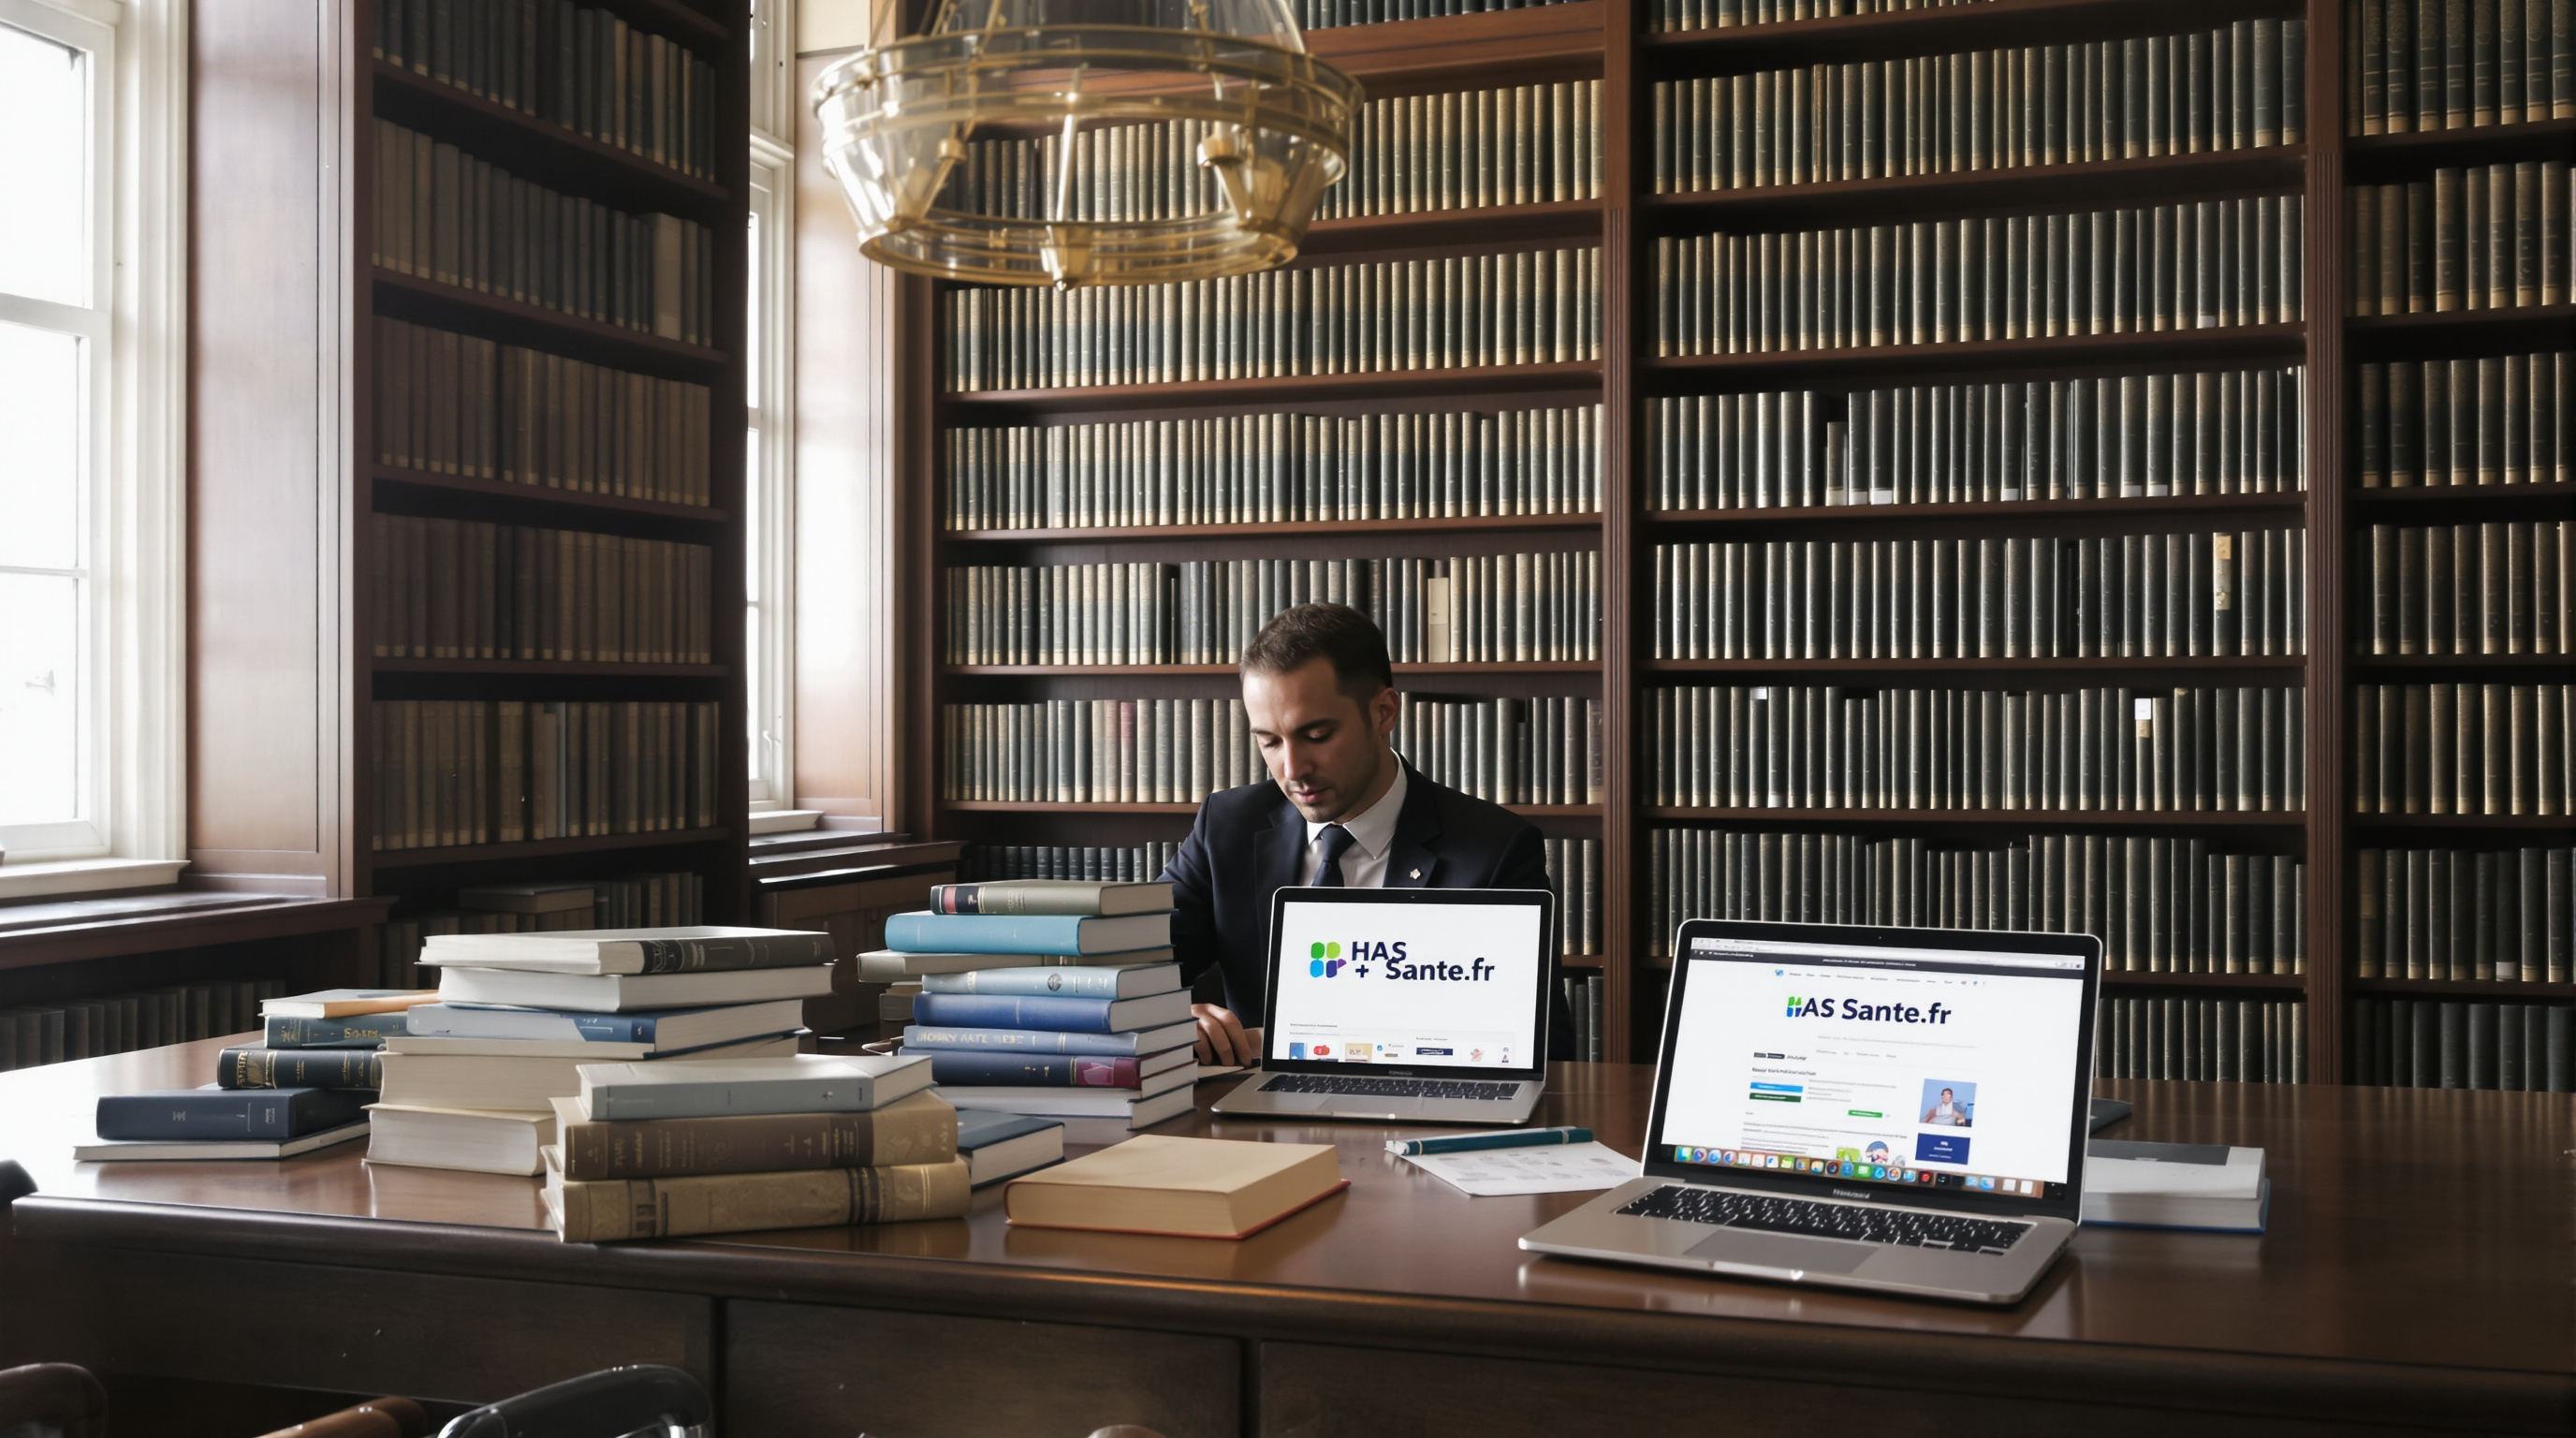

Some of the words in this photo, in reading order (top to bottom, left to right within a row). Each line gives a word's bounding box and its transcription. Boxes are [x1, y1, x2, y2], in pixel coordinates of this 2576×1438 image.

[1351, 941, 1407, 963] HAS
[1385, 957, 1496, 982] Sante.fr
[1841, 998, 1953, 1025] Sante.fr
